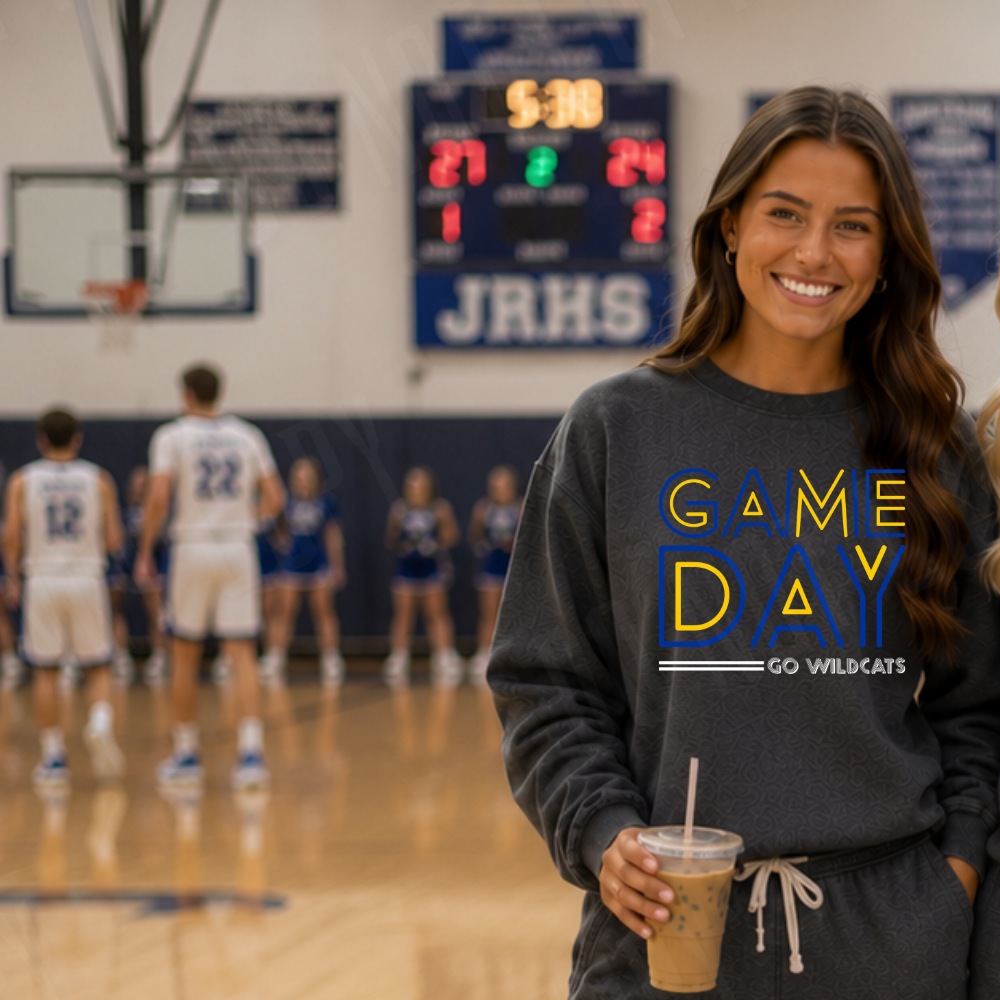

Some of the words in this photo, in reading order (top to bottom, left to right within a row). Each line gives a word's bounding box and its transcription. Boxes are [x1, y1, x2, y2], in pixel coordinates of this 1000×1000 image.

[429, 139, 486, 188] 27
[606, 138, 666, 187] 24
[441, 201, 461, 243] 1
[631, 197, 666, 243] 2
[435, 273, 650, 344] JRHS
[194, 452, 242, 500] 22
[45, 501, 83, 541] 12
[659, 468, 906, 538] GAME
[659, 545, 906, 648] DAY
[767, 657, 799, 674] GO
[805, 657, 906, 675] WILDCATS
